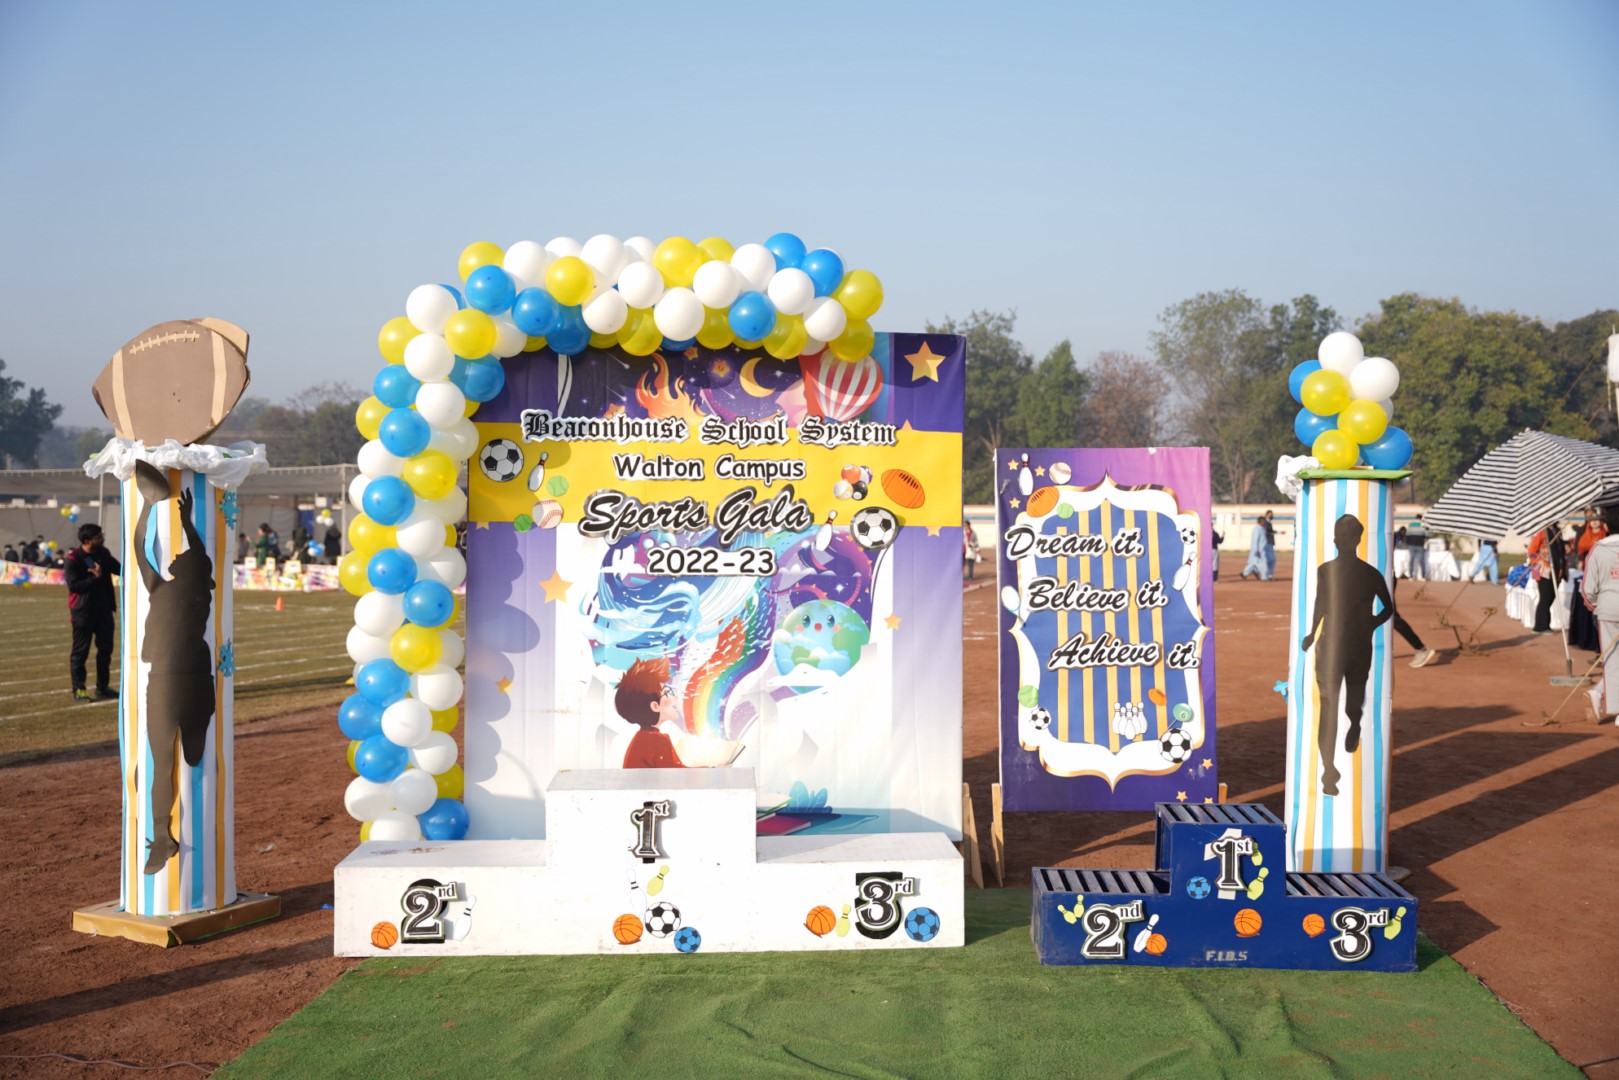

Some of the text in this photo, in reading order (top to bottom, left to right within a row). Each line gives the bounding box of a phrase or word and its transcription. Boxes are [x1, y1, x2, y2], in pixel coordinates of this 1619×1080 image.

[523, 412, 896, 447] Beaconhouse School System
[614, 455, 805, 485] Walton Campus
[583, 487, 811, 543] Sports Gala
[649, 550, 775, 575] 2022-23
[1008, 527, 1143, 555] Dream it.
[1029, 581, 1167, 610] Believe it.
[1050, 634, 1199, 667] Achieve it.
[634, 801, 670, 856] 1st
[1213, 837, 1252, 890] 1st
[405, 883, 456, 937] 2nd
[860, 879, 912, 927] 3rd
[1085, 902, 1142, 956] 2nd
[1333, 908, 1388, 959] 3rd
